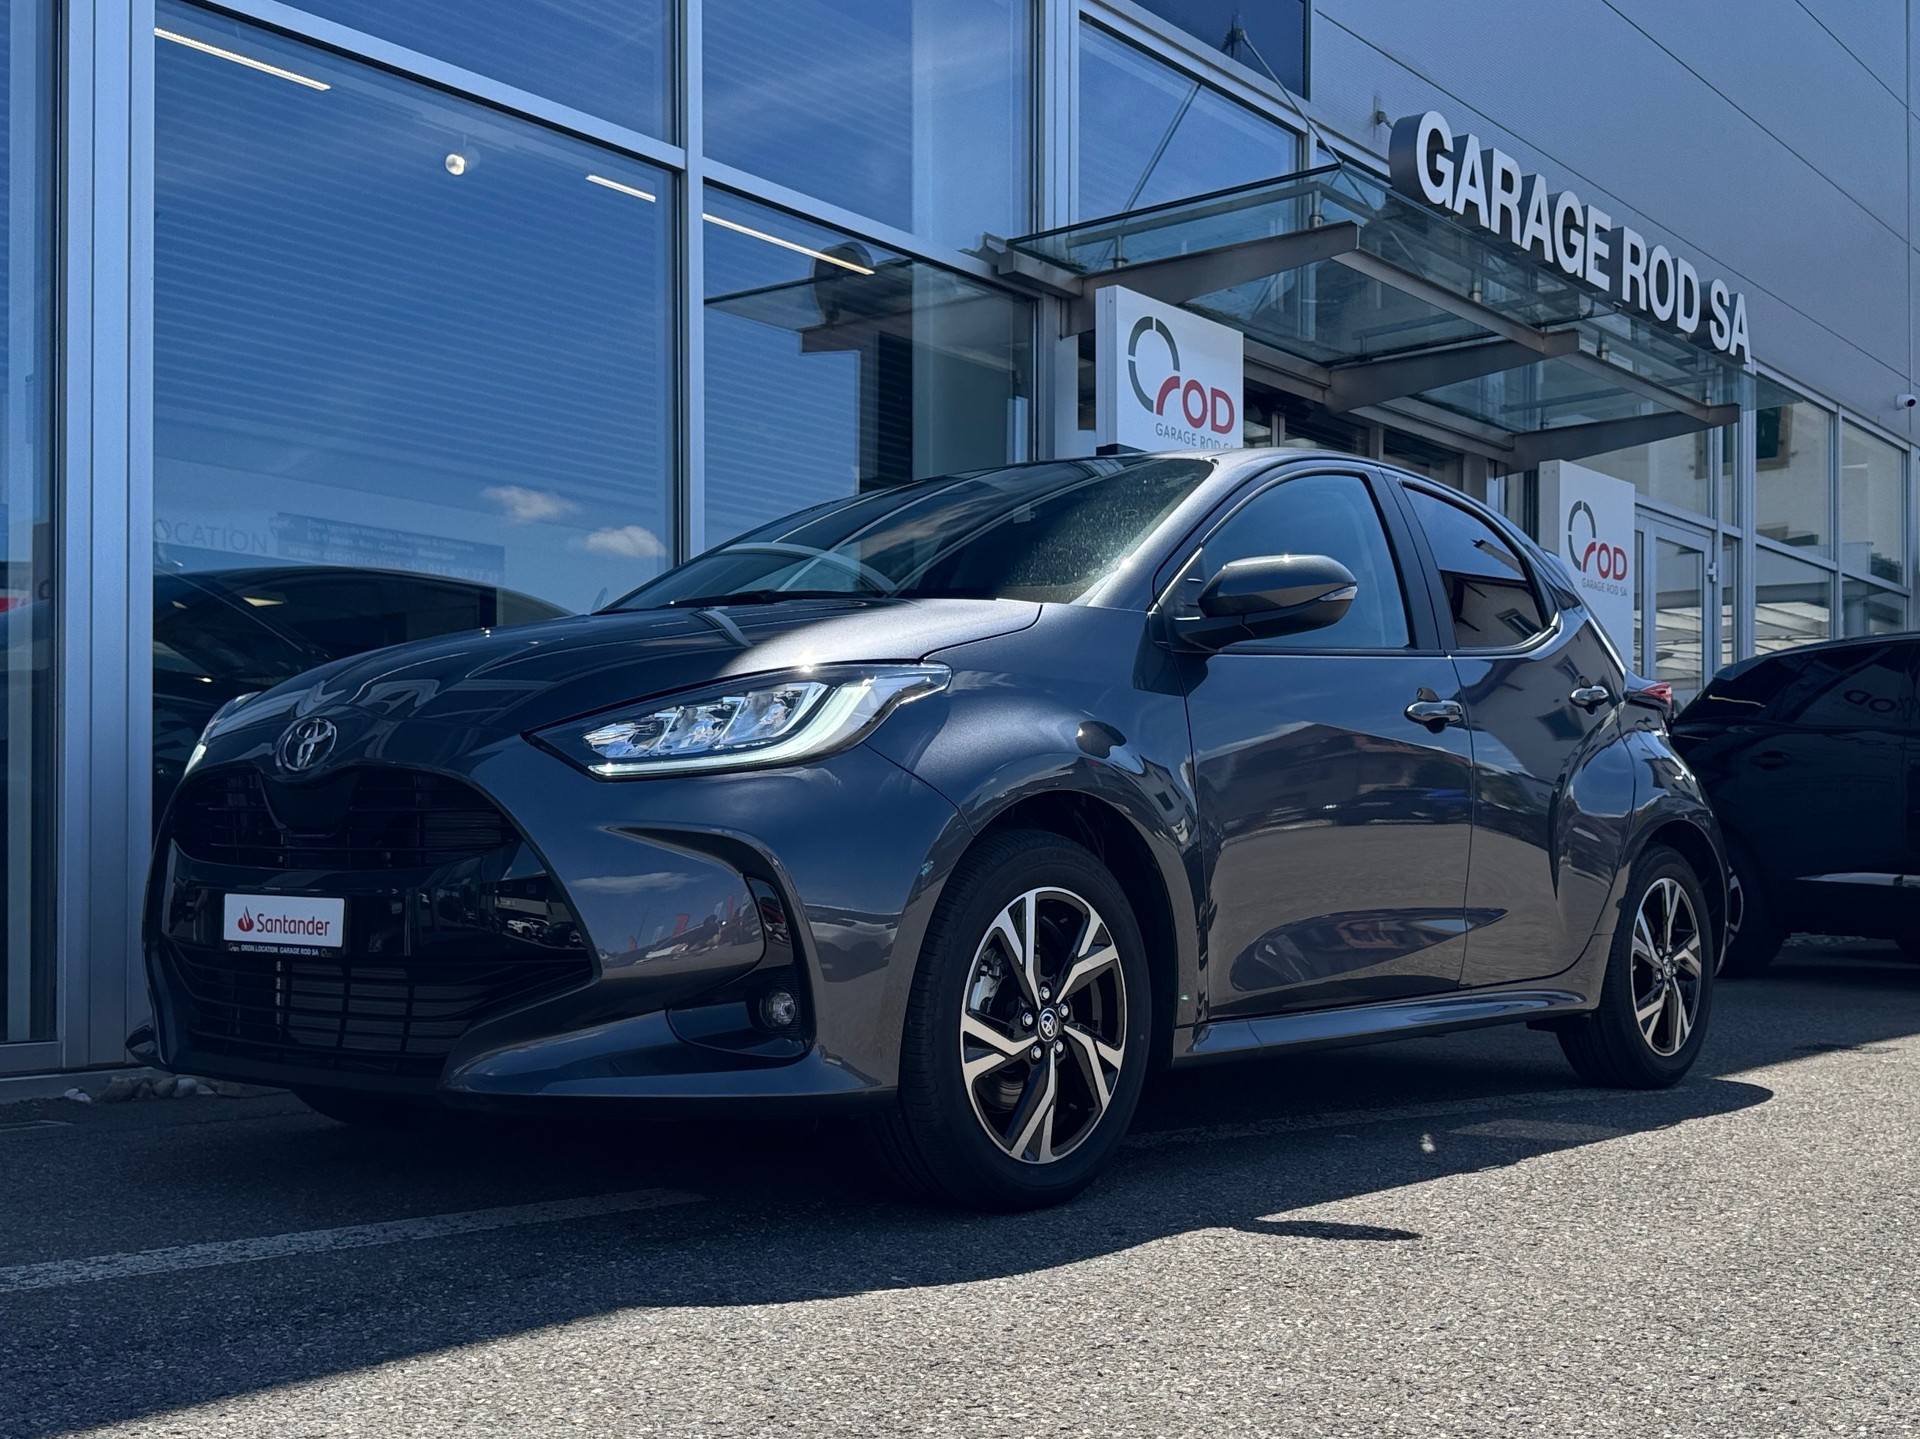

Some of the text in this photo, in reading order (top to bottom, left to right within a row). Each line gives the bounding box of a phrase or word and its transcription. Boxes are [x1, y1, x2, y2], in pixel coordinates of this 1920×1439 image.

[1416, 110, 1751, 364] GARAGE ROD SA
[1155, 423, 1197, 447] GARAGE
[1582, 577, 1628, 598] GARAGE ROD SA
[256, 913, 331, 936] Santander
[279, 946, 300, 955] GARAGE
